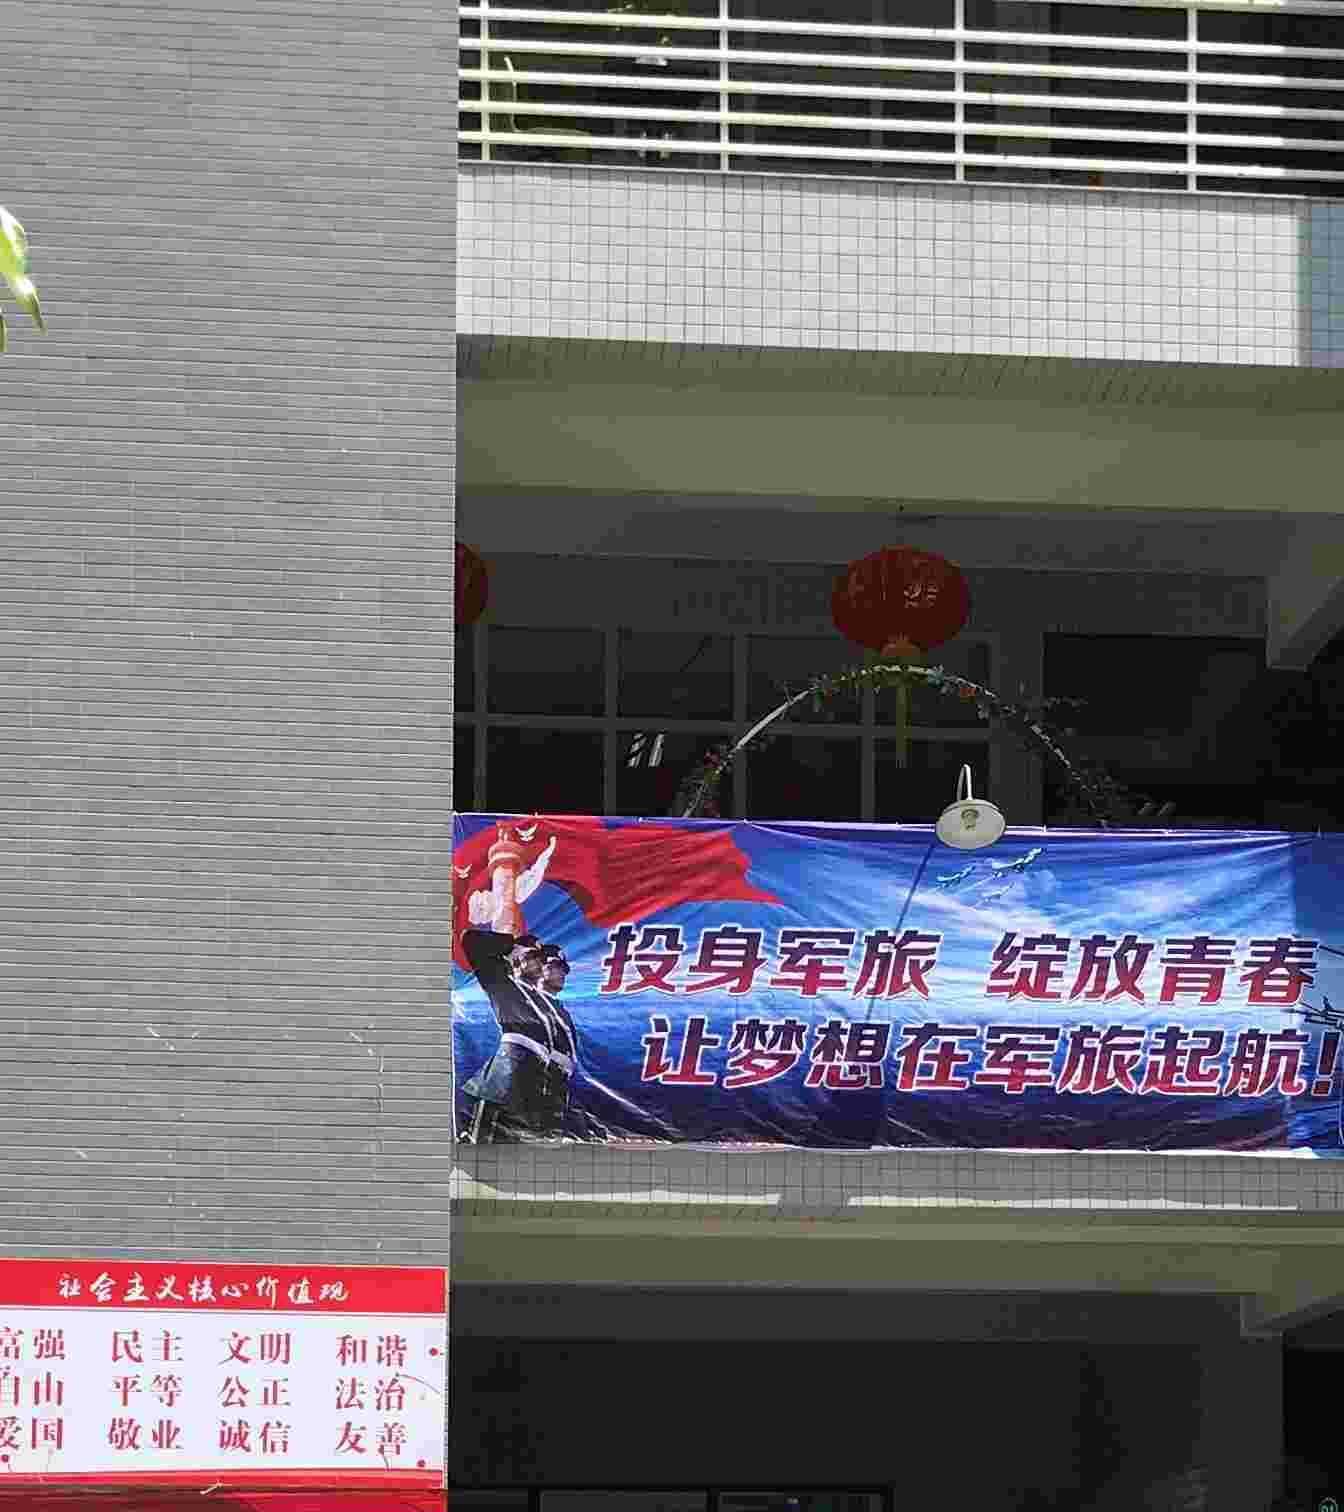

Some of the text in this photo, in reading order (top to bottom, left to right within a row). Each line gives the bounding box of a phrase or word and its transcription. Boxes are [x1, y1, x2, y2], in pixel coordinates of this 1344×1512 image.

[598, 921, 1320, 1007] 投身军旅 绽放青春
[640, 1015, 1341, 1098] 让梦想在军旅起航！
[58, 1272, 350, 1307] 社会主义核心价值观
[111, 1329, 184, 1364] 民主
[218, 1331, 292, 1365] 文明
[335, 1333, 408, 1368] 和谐
[111, 1374, 183, 1408] 平等
[218, 1375, 291, 1409] 公正
[335, 1377, 407, 1411] 法治
[107, 1417, 184, 1451] 敬业
[218, 1418, 291, 1454] 诚信
[335, 1421, 408, 1457] 友善
